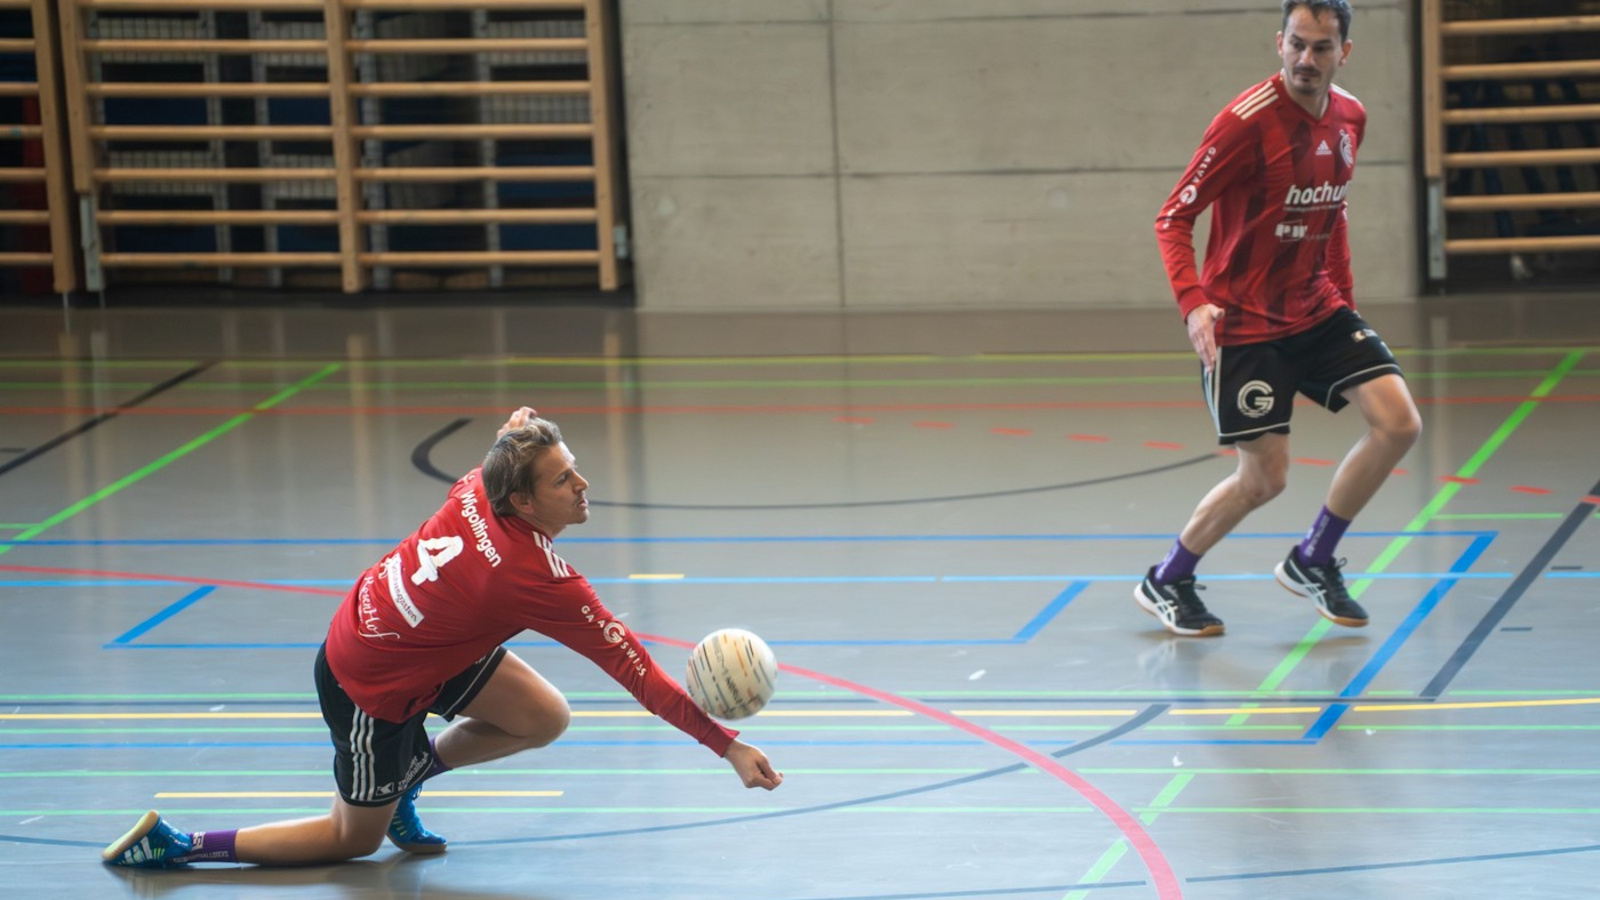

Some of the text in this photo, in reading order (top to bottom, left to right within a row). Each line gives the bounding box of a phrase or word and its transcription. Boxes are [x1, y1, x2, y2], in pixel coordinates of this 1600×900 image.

[460, 489, 502, 568] Wigoltingen
[411, 535, 464, 586] 4
[620, 641, 647, 676] SWISS
